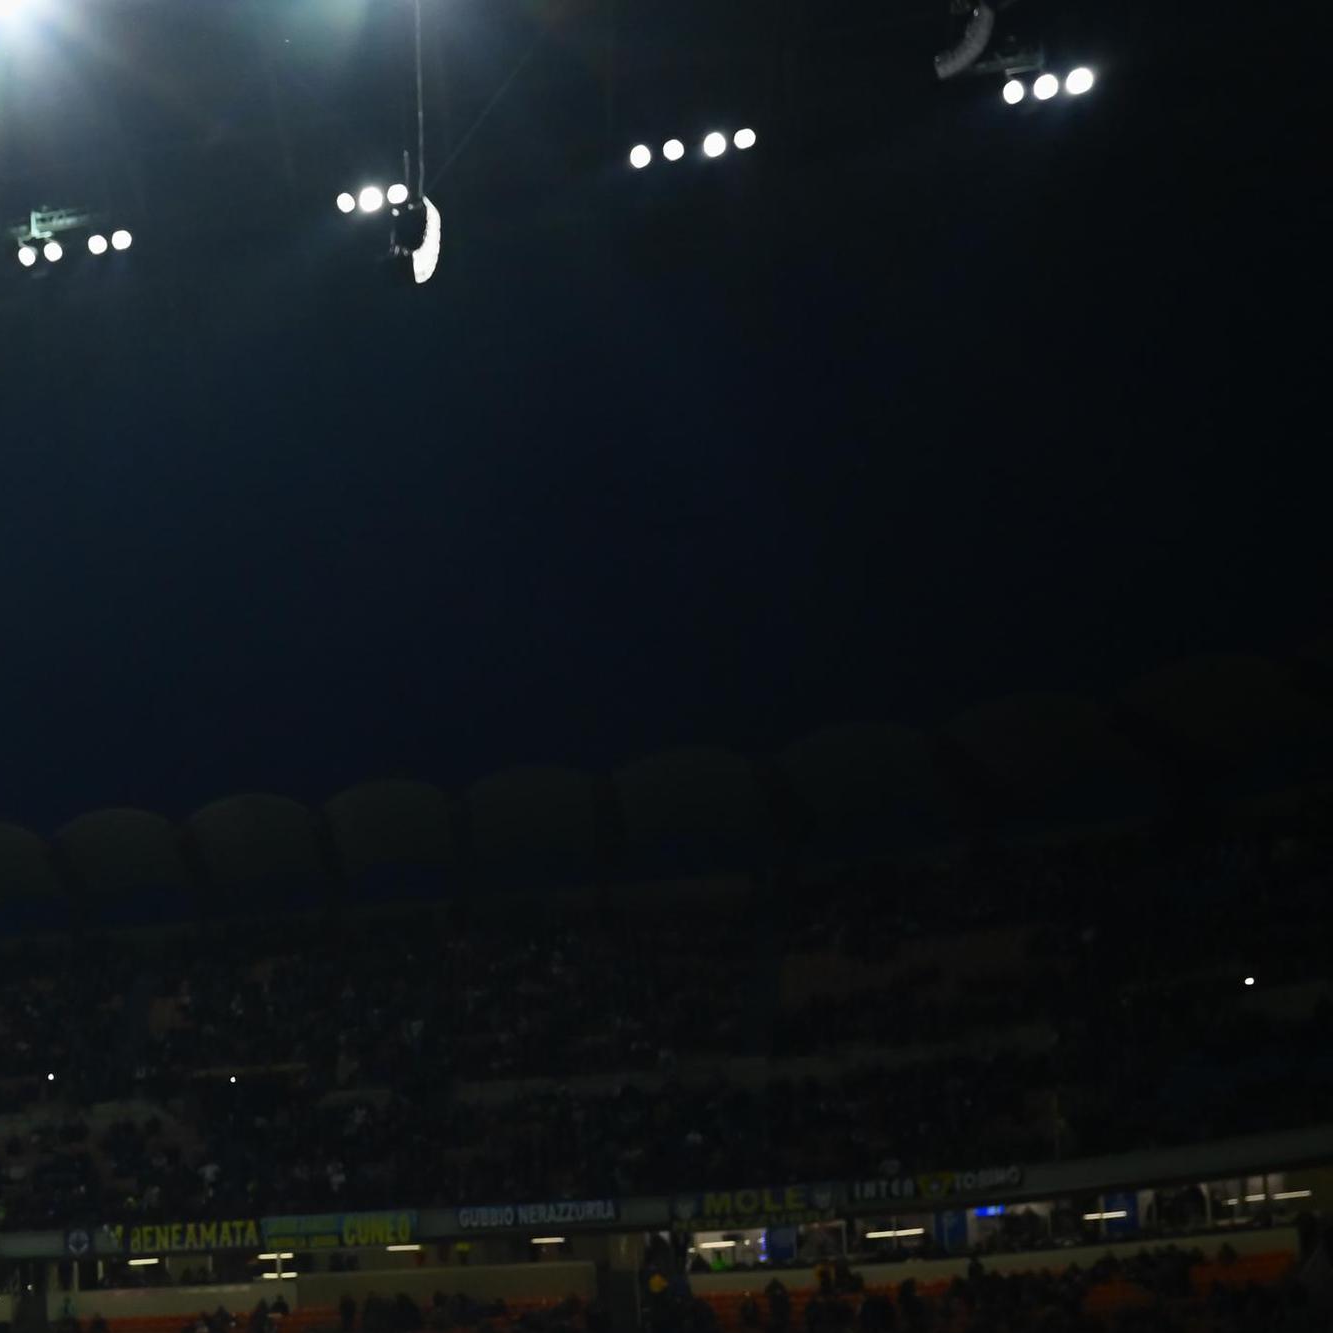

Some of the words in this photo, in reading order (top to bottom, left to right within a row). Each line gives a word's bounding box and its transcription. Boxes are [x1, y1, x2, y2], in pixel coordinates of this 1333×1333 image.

[459, 1206, 514, 1228] GUBBIO
[516, 1200, 617, 1225] NERAZZURRA
[704, 1185, 806, 1216] MOLE
[130, 1219, 260, 1252] BENEAMATA
[341, 1214, 412, 1246] CUNEO
